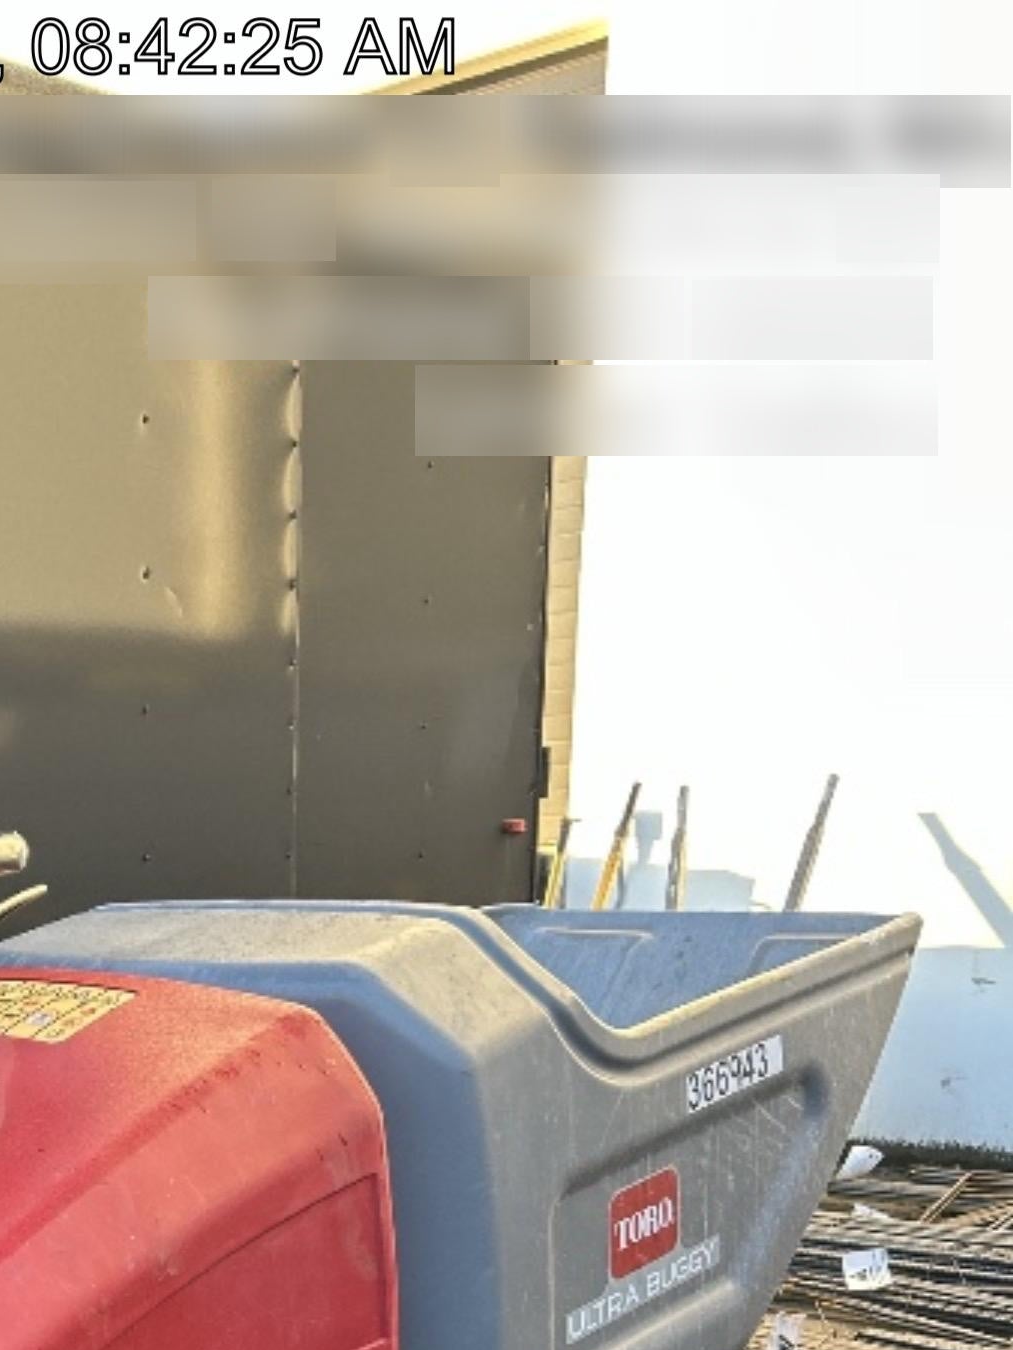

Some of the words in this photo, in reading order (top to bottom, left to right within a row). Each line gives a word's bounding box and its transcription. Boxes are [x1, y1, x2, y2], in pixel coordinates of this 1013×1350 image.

[688, 1043, 768, 1109] 366943
[613, 1196, 674, 1250] TORO
[567, 1283, 639, 1338] ULTRA
[646, 1238, 718, 1297] BUGGY
